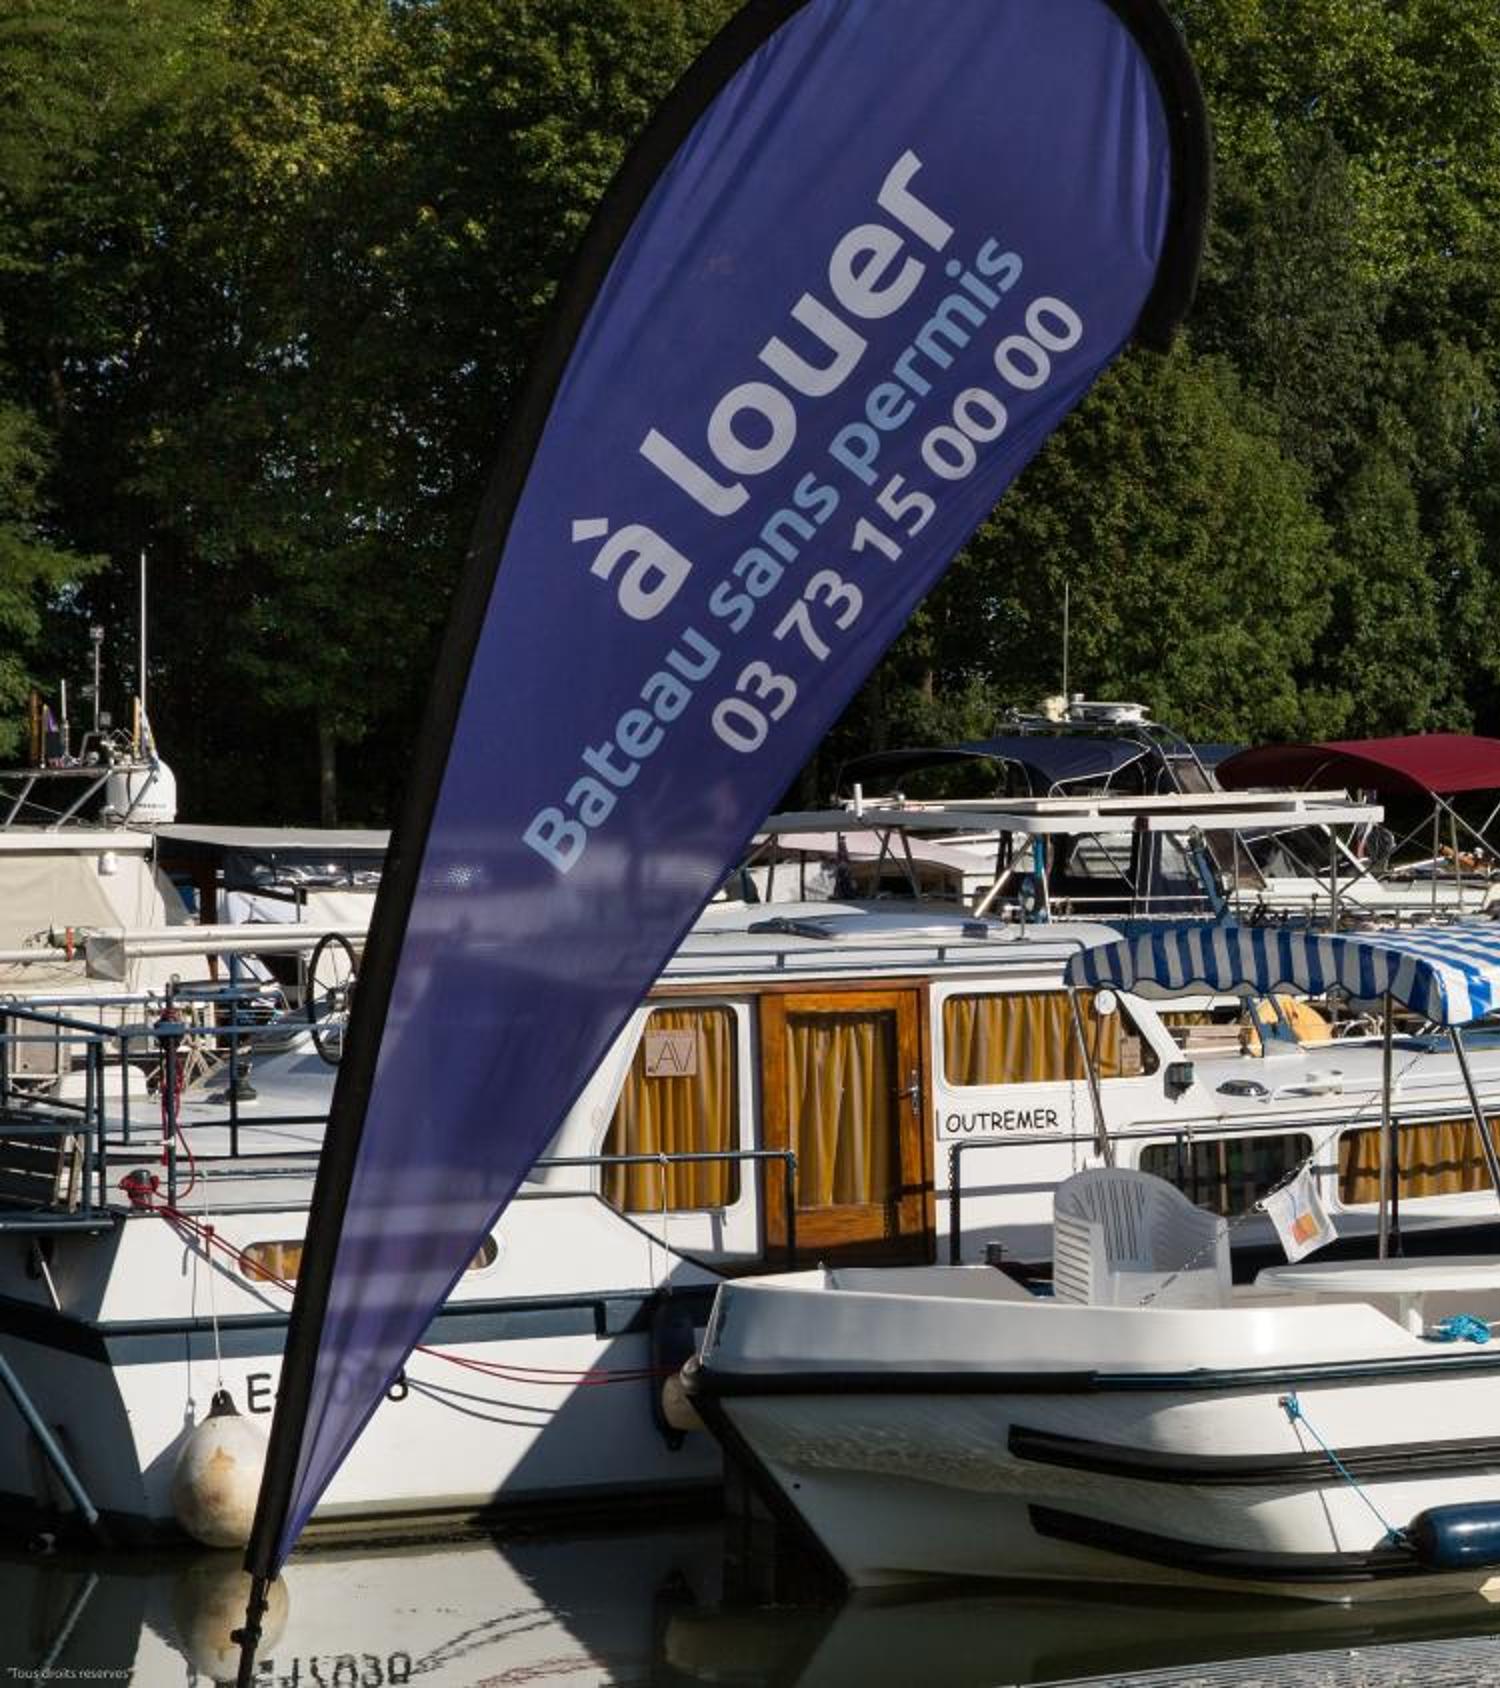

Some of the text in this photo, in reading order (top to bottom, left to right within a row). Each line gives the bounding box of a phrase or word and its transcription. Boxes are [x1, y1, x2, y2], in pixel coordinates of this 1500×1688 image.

[522, 237, 1023, 874] Bateau sans permis
[572, 149, 954, 621] à louer
[711, 296, 1083, 753] 03 73 15 00 00
[945, 1109, 1059, 1133] OUTREMER
